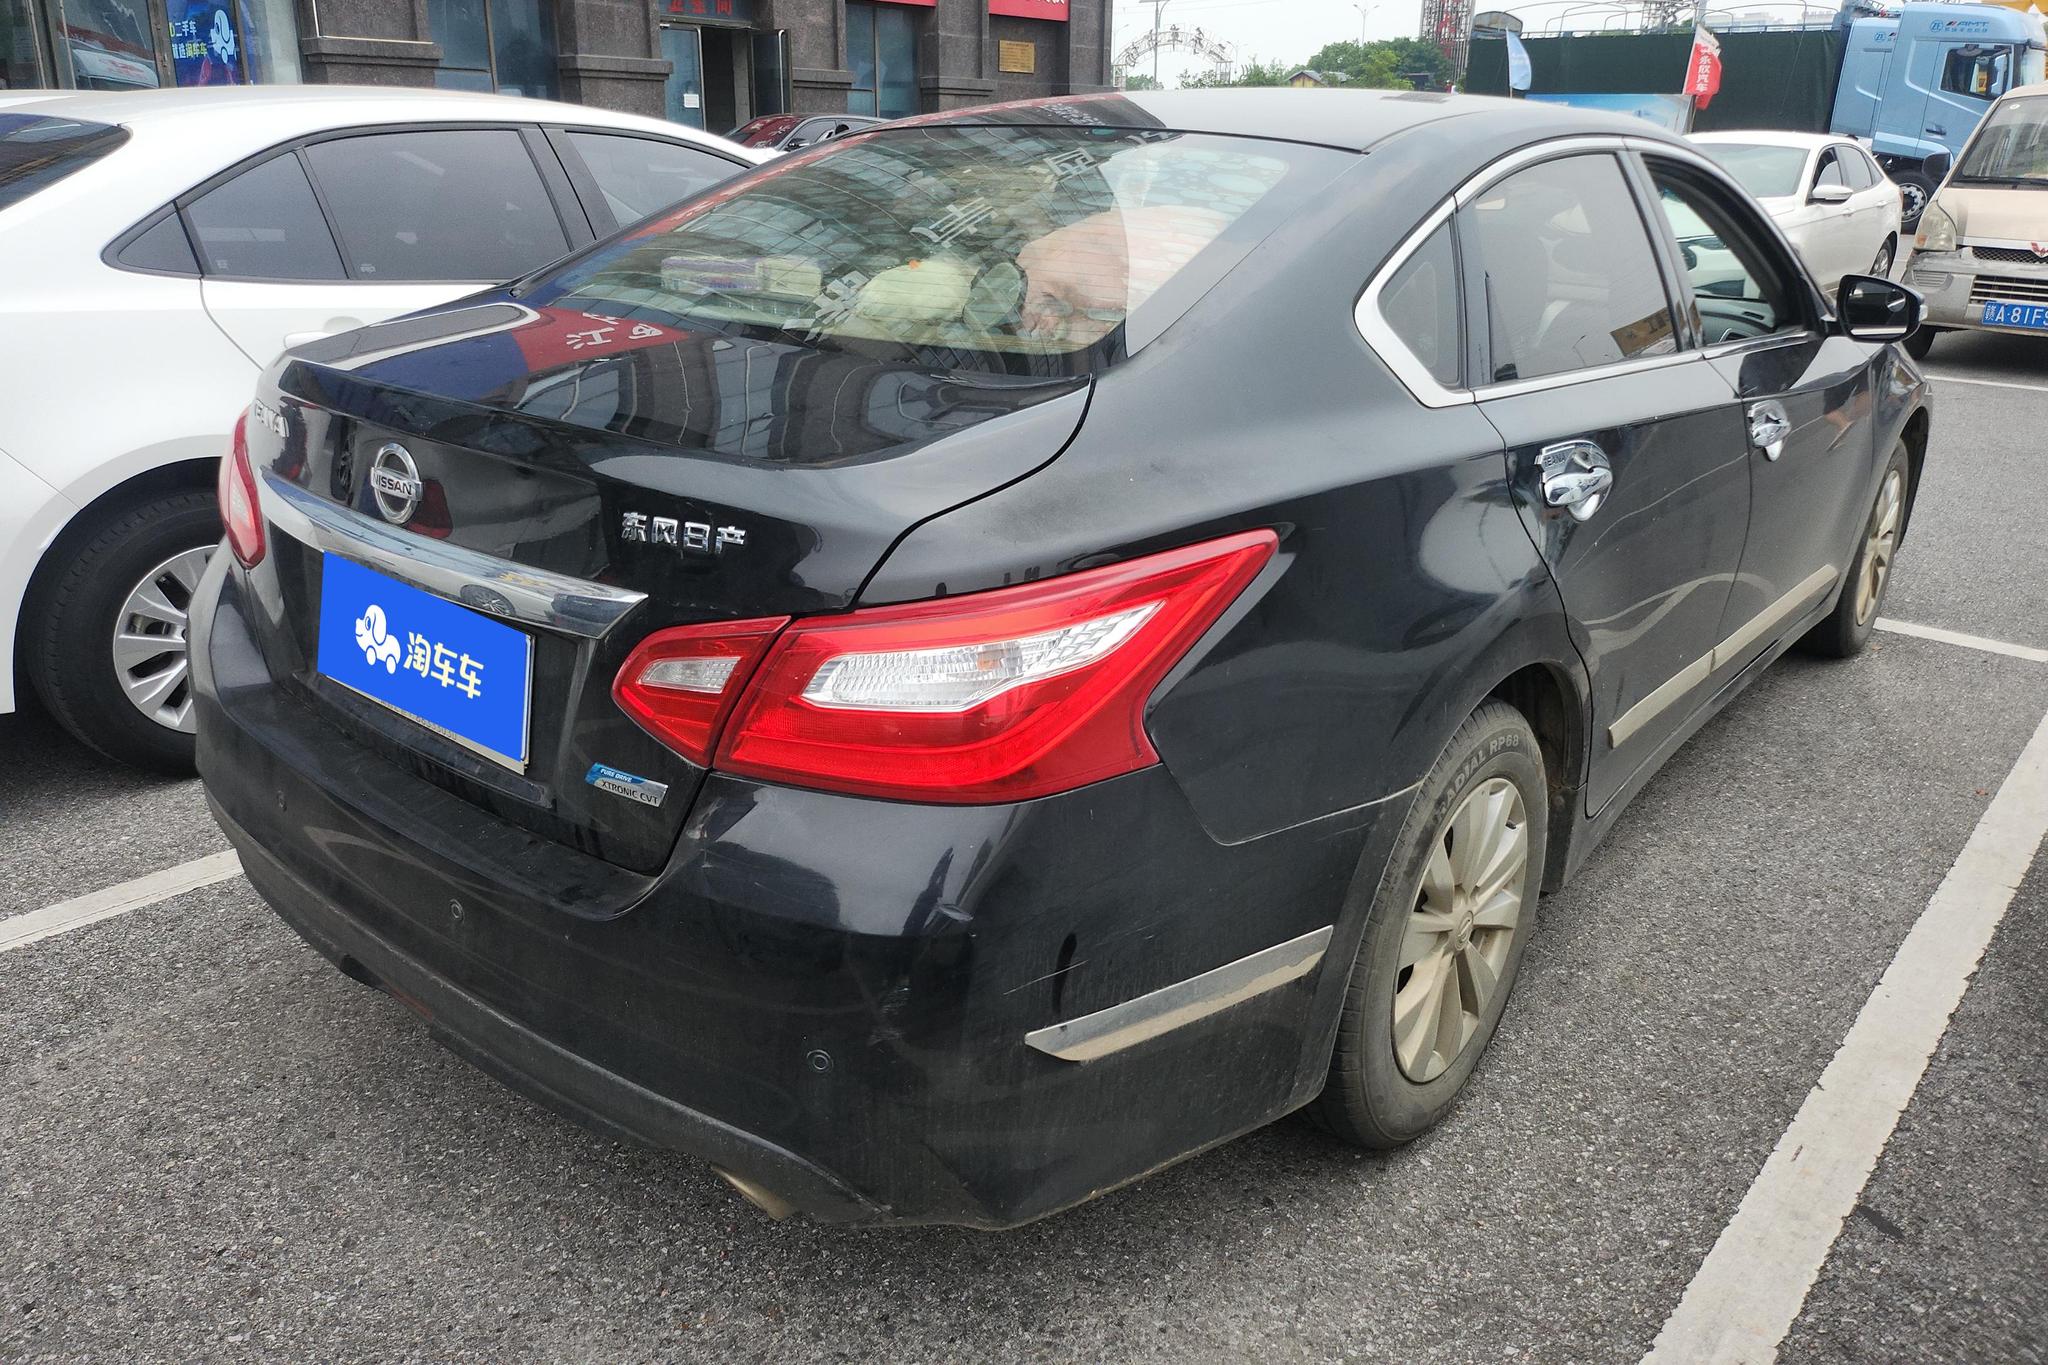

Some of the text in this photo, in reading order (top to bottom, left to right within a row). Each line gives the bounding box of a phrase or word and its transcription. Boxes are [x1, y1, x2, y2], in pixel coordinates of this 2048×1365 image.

[374, 472, 412, 496] NISSAN
[621, 512, 746, 554] 东风日产
[615, 774, 632, 782] DRIVE
[602, 779, 658, 804] XTRONIC CVT
